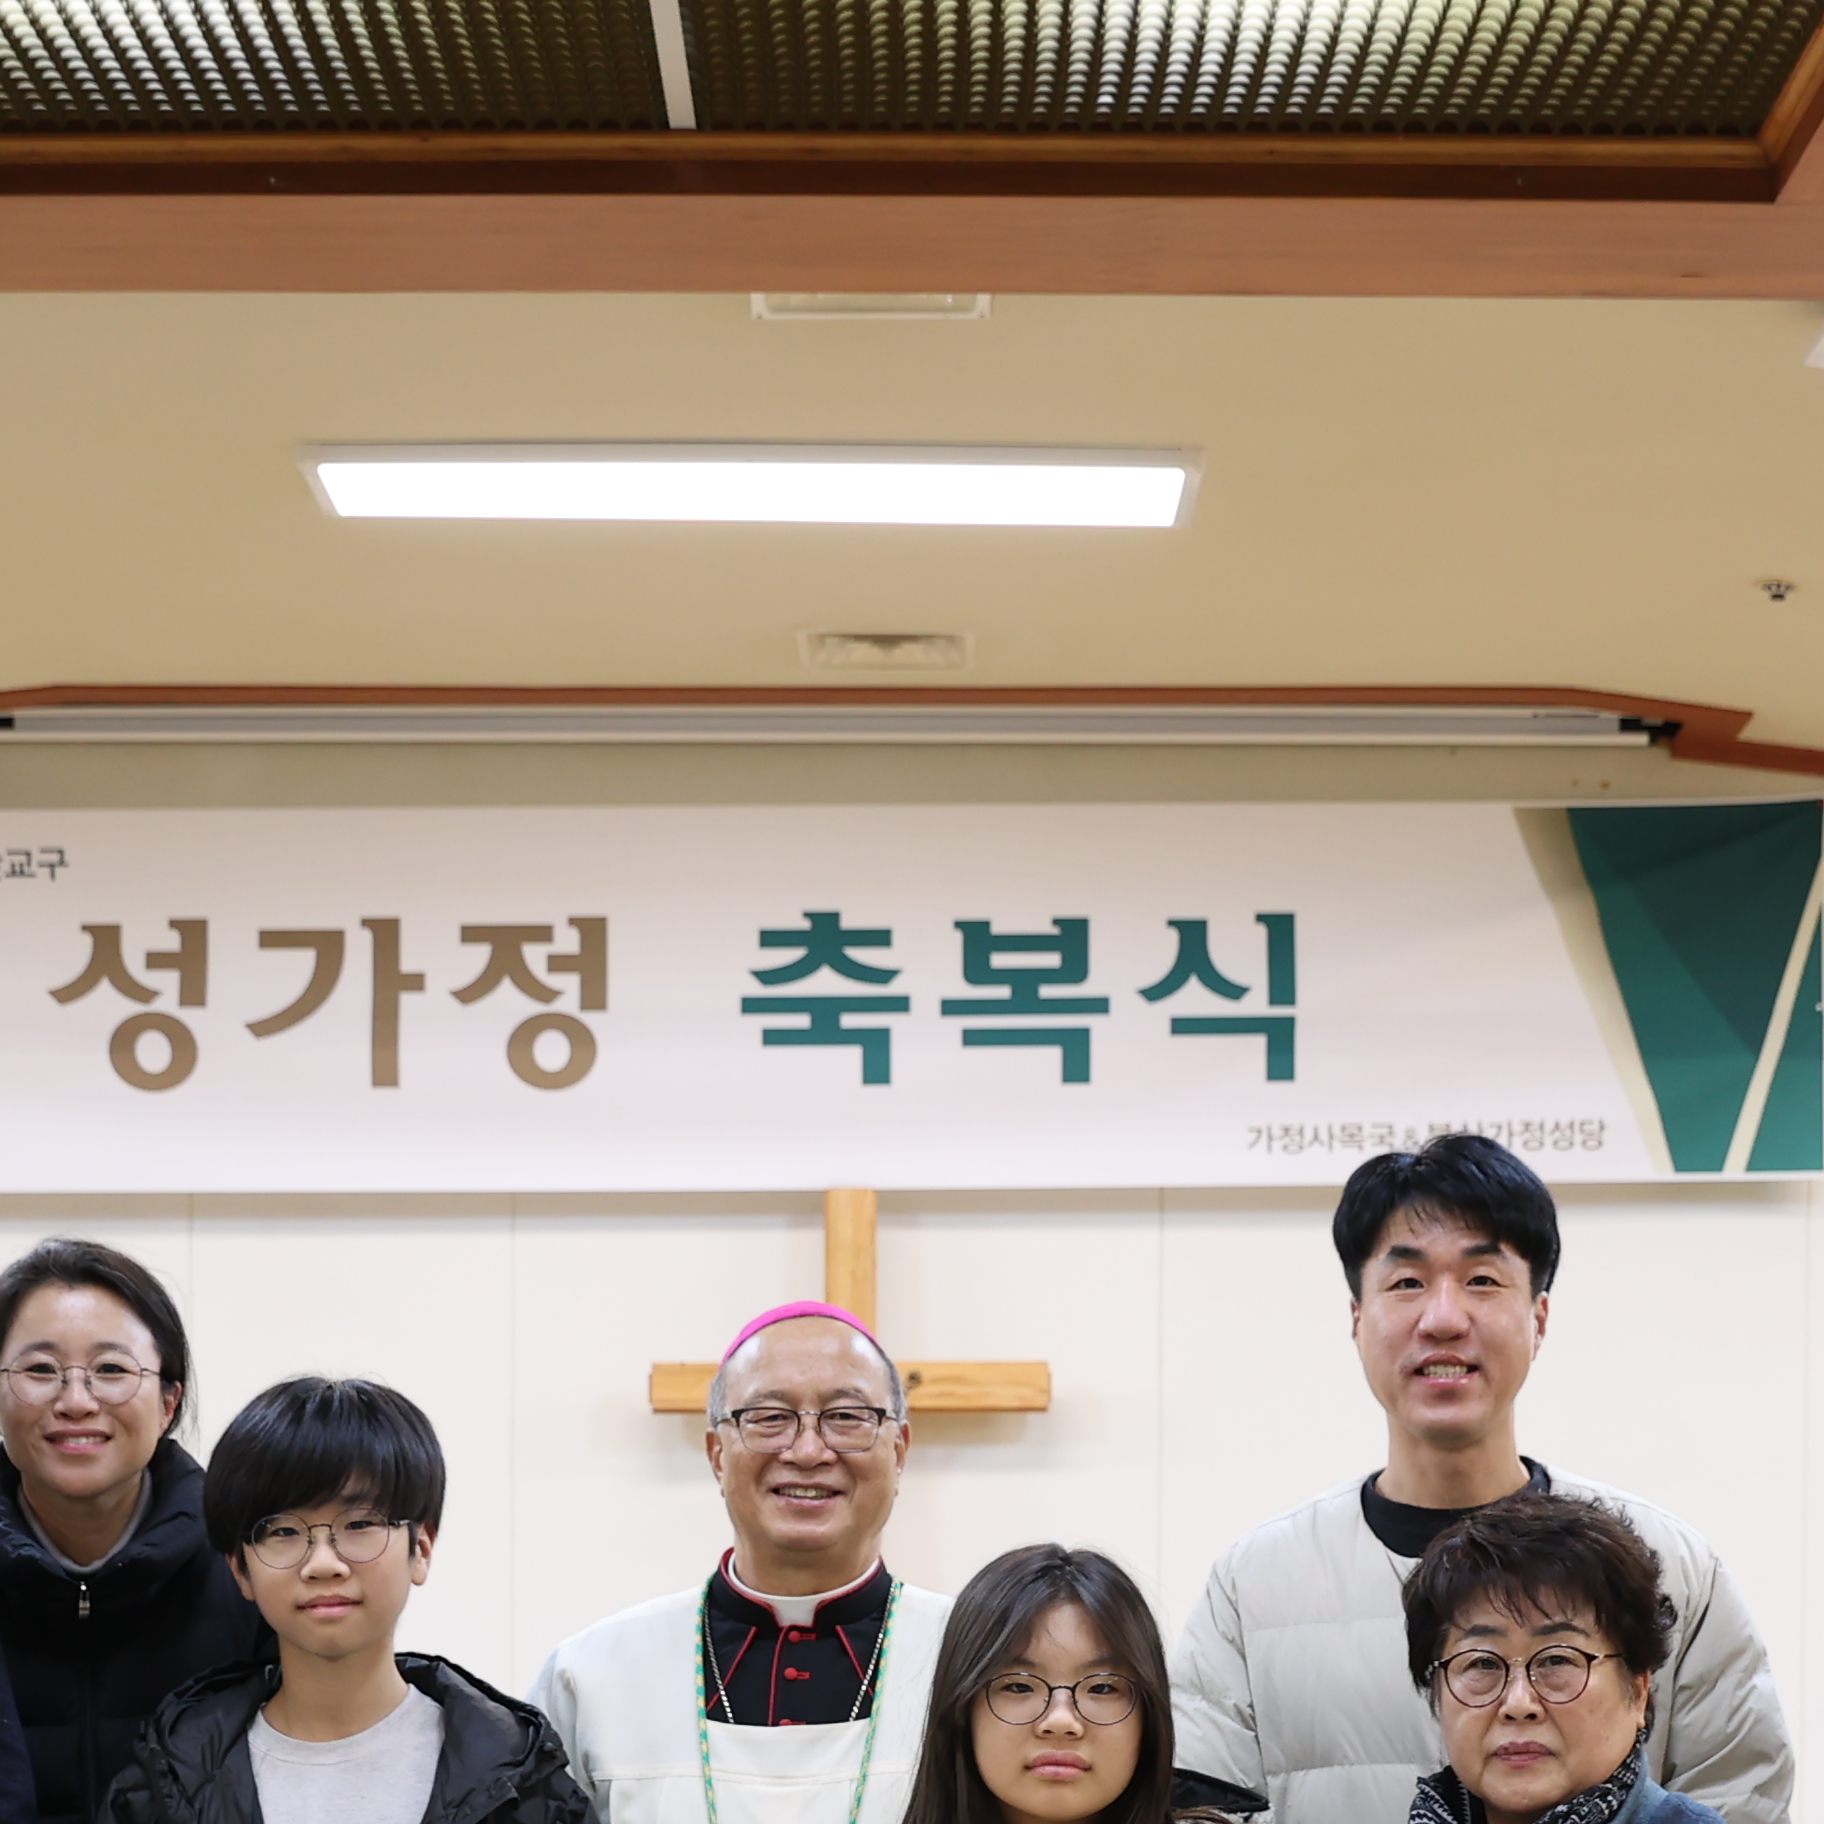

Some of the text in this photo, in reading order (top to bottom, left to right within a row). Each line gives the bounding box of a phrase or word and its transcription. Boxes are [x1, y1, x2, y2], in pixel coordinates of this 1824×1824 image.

[48, 910, 1297, 1092] 성가정 축복식
[1248, 1122, 1394, 1154] 가정사목국
